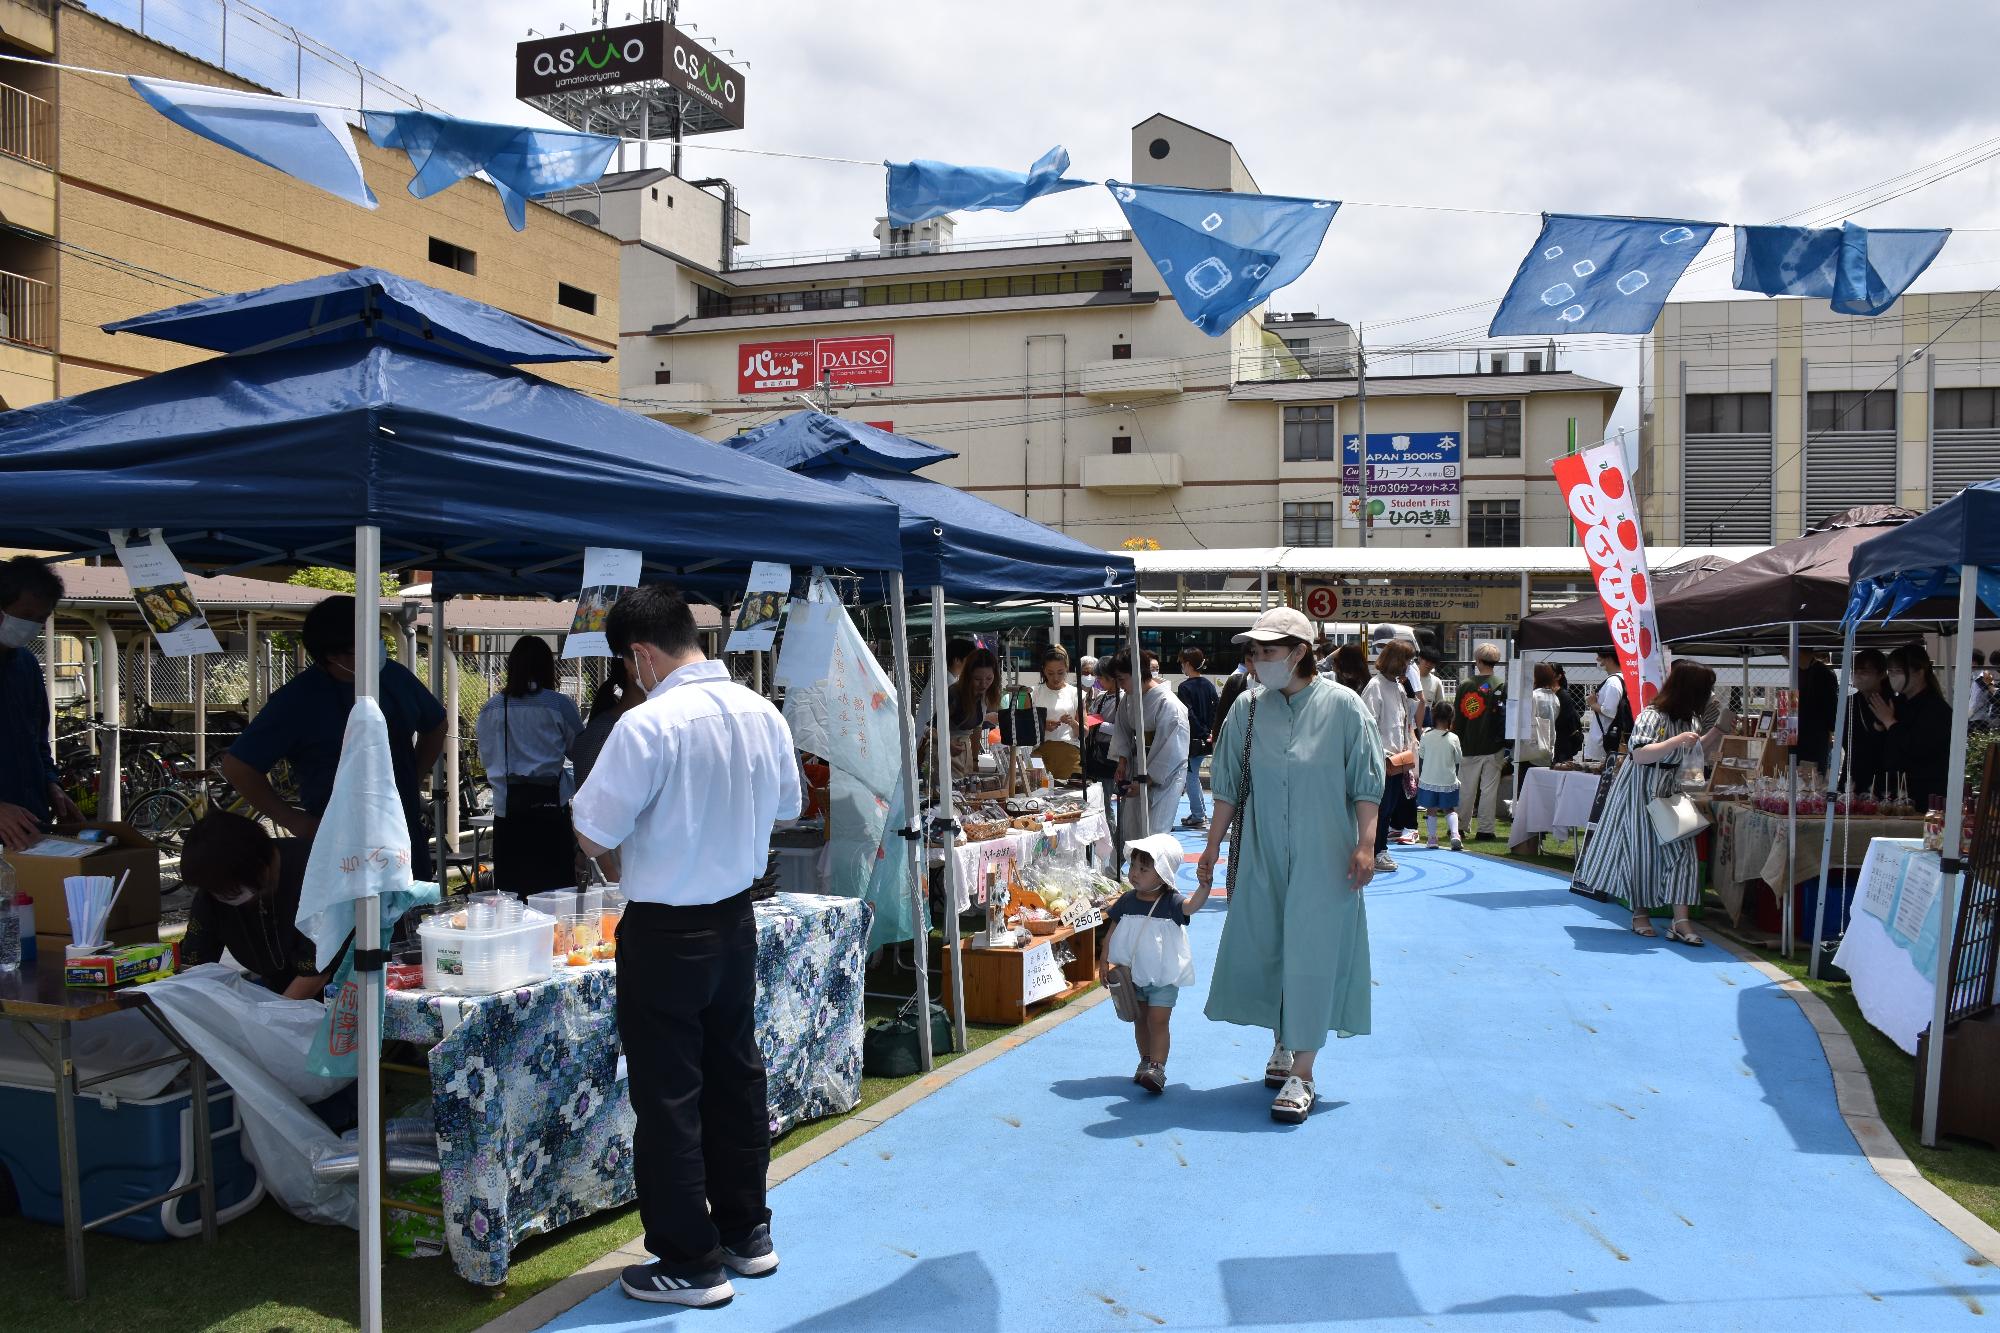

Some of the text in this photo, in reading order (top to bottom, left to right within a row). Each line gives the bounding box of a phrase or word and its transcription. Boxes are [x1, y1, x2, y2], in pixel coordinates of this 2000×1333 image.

[555, 71, 620, 88] yamatokoriyama
[743, 350, 804, 378] パレット
[822, 349, 888, 368] DAISO
[1436, 435, 1457, 451] 本
[1366, 452, 1442, 461] APAN BOOKS
[1377, 466, 1422, 479] カーブス
[1391, 498, 1451, 508] Student First
[1388, 509, 1451, 526] ひのき塾
[1313, 590, 1331, 617] 3
[1341, 610, 1441, 620] イオンモール大和郡山
[1074, 910, 1102, 928] 250円
